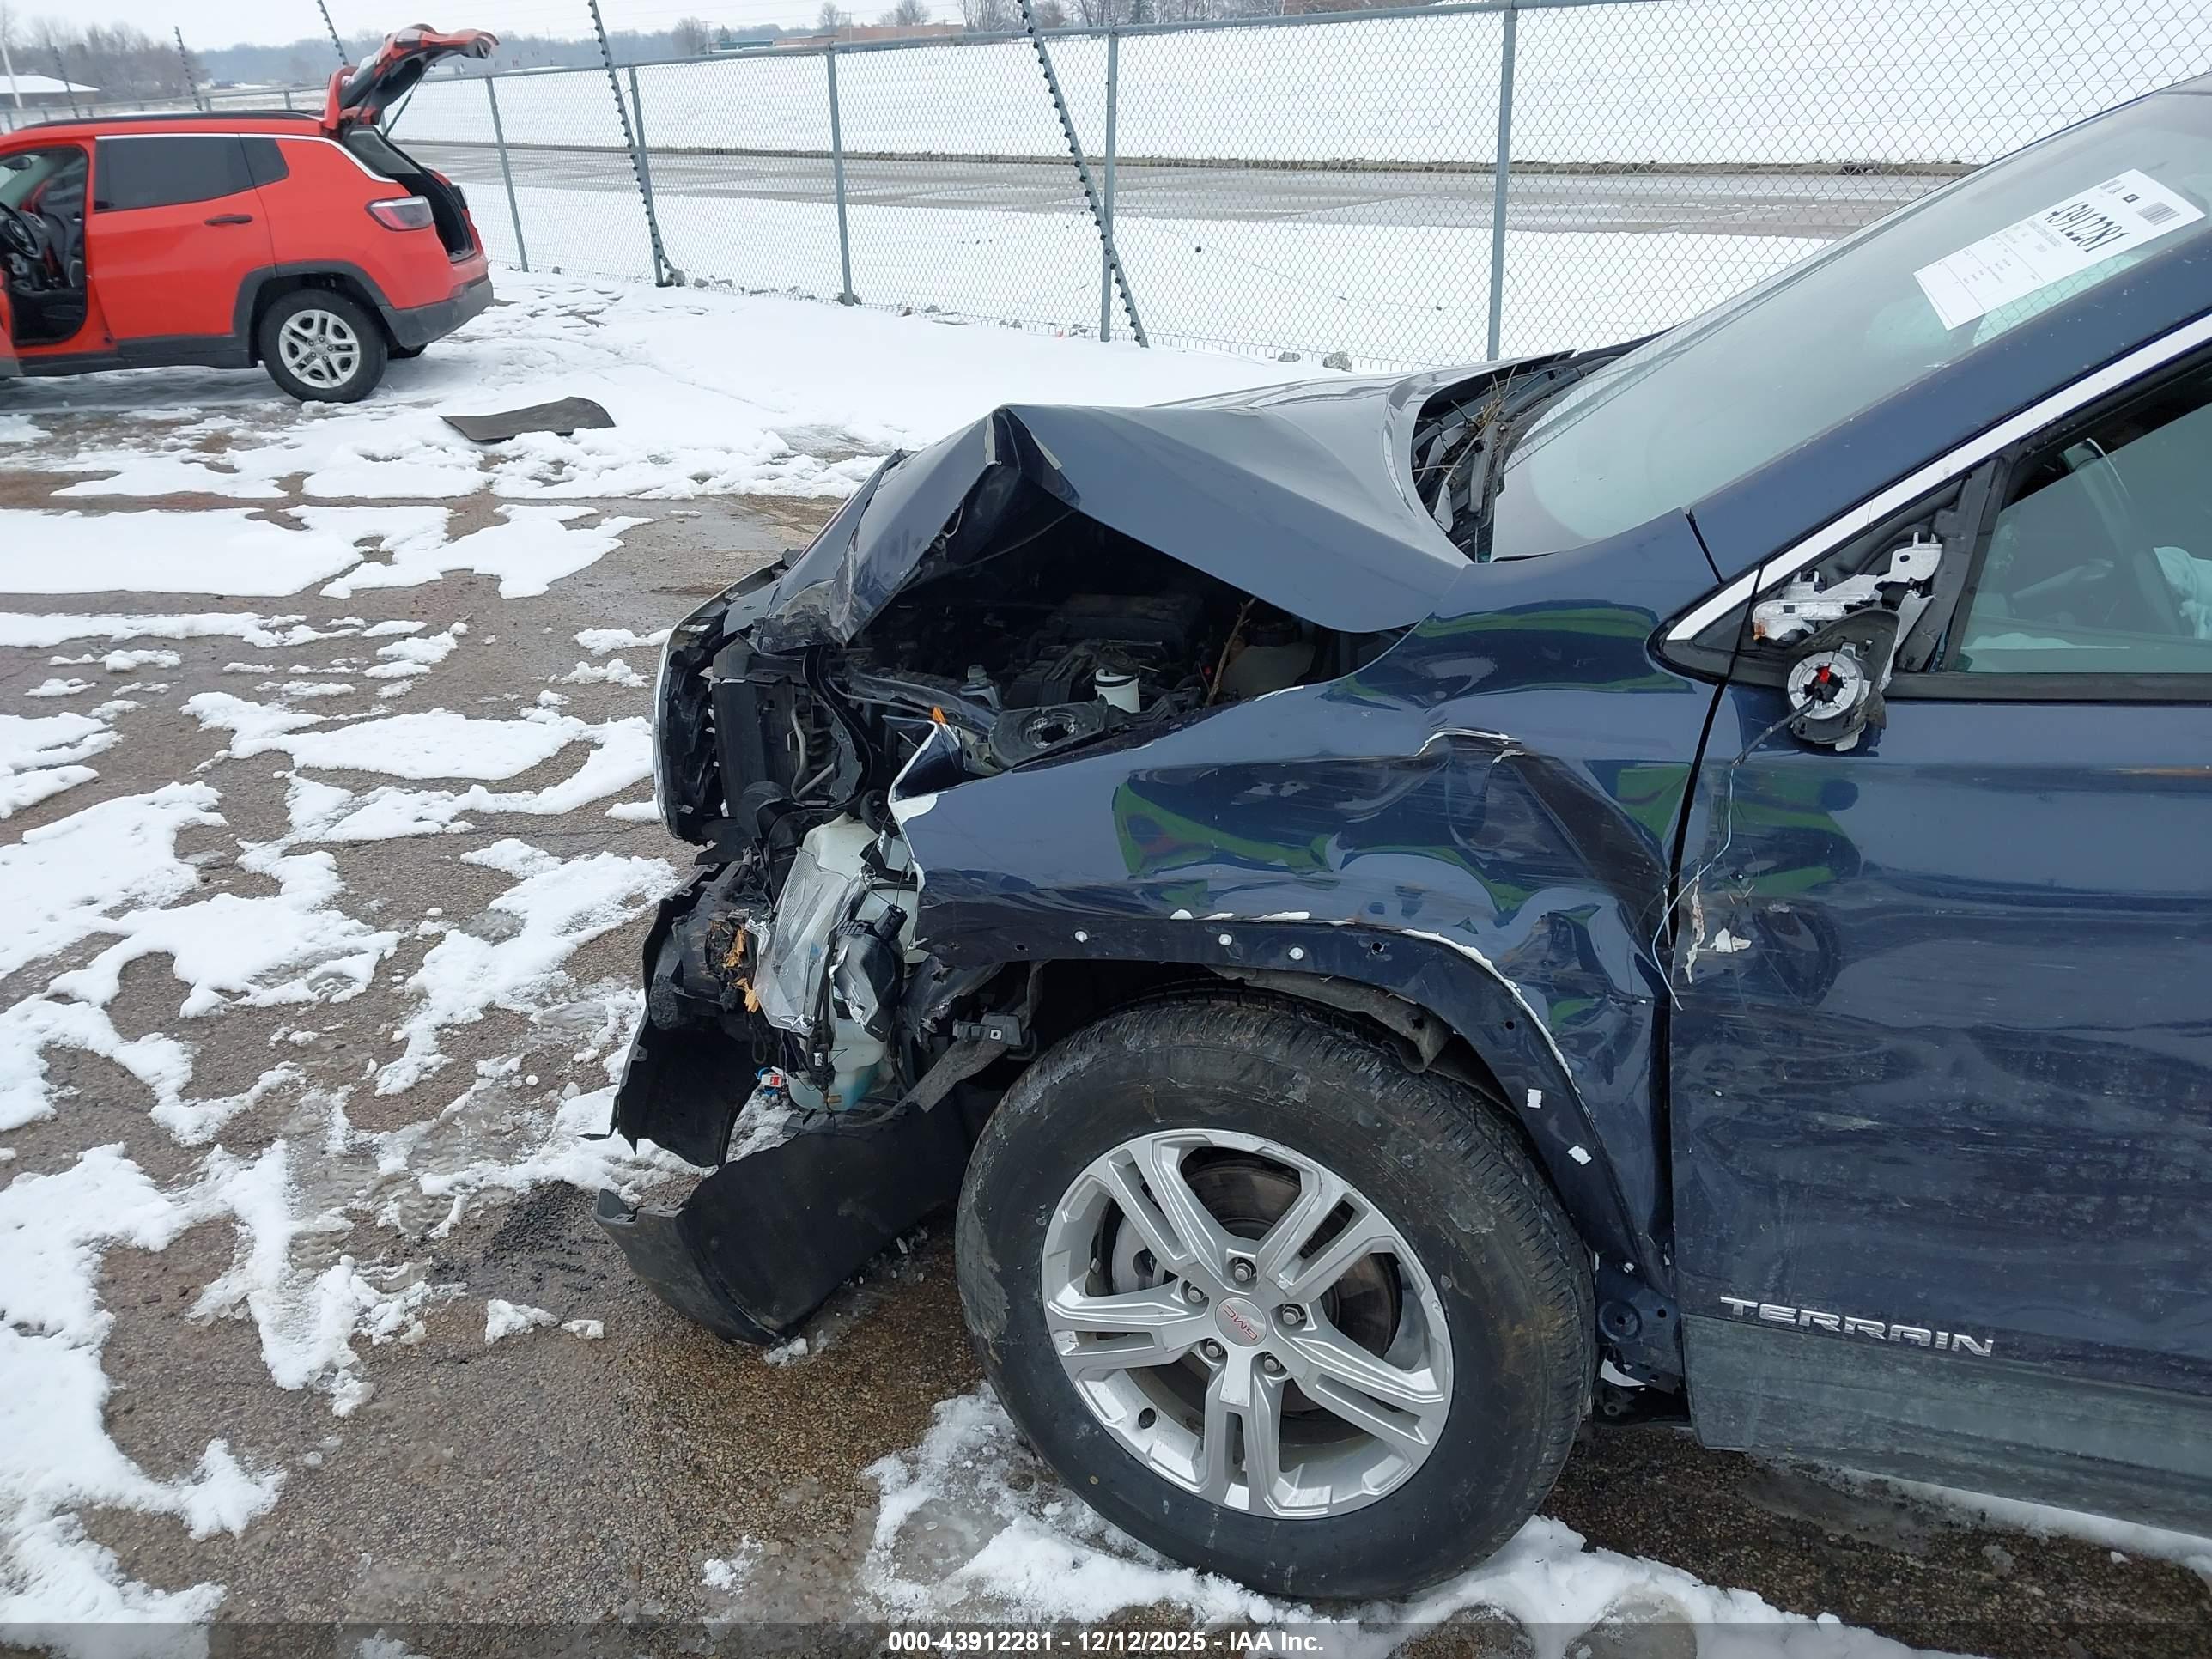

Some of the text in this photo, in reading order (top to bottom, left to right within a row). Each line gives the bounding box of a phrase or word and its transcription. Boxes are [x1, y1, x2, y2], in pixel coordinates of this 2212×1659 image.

[2045, 202, 2130, 252] 43912281
[1223, 1304, 1258, 1340] GMC
[1719, 1296, 1995, 1358] TERRAIN
